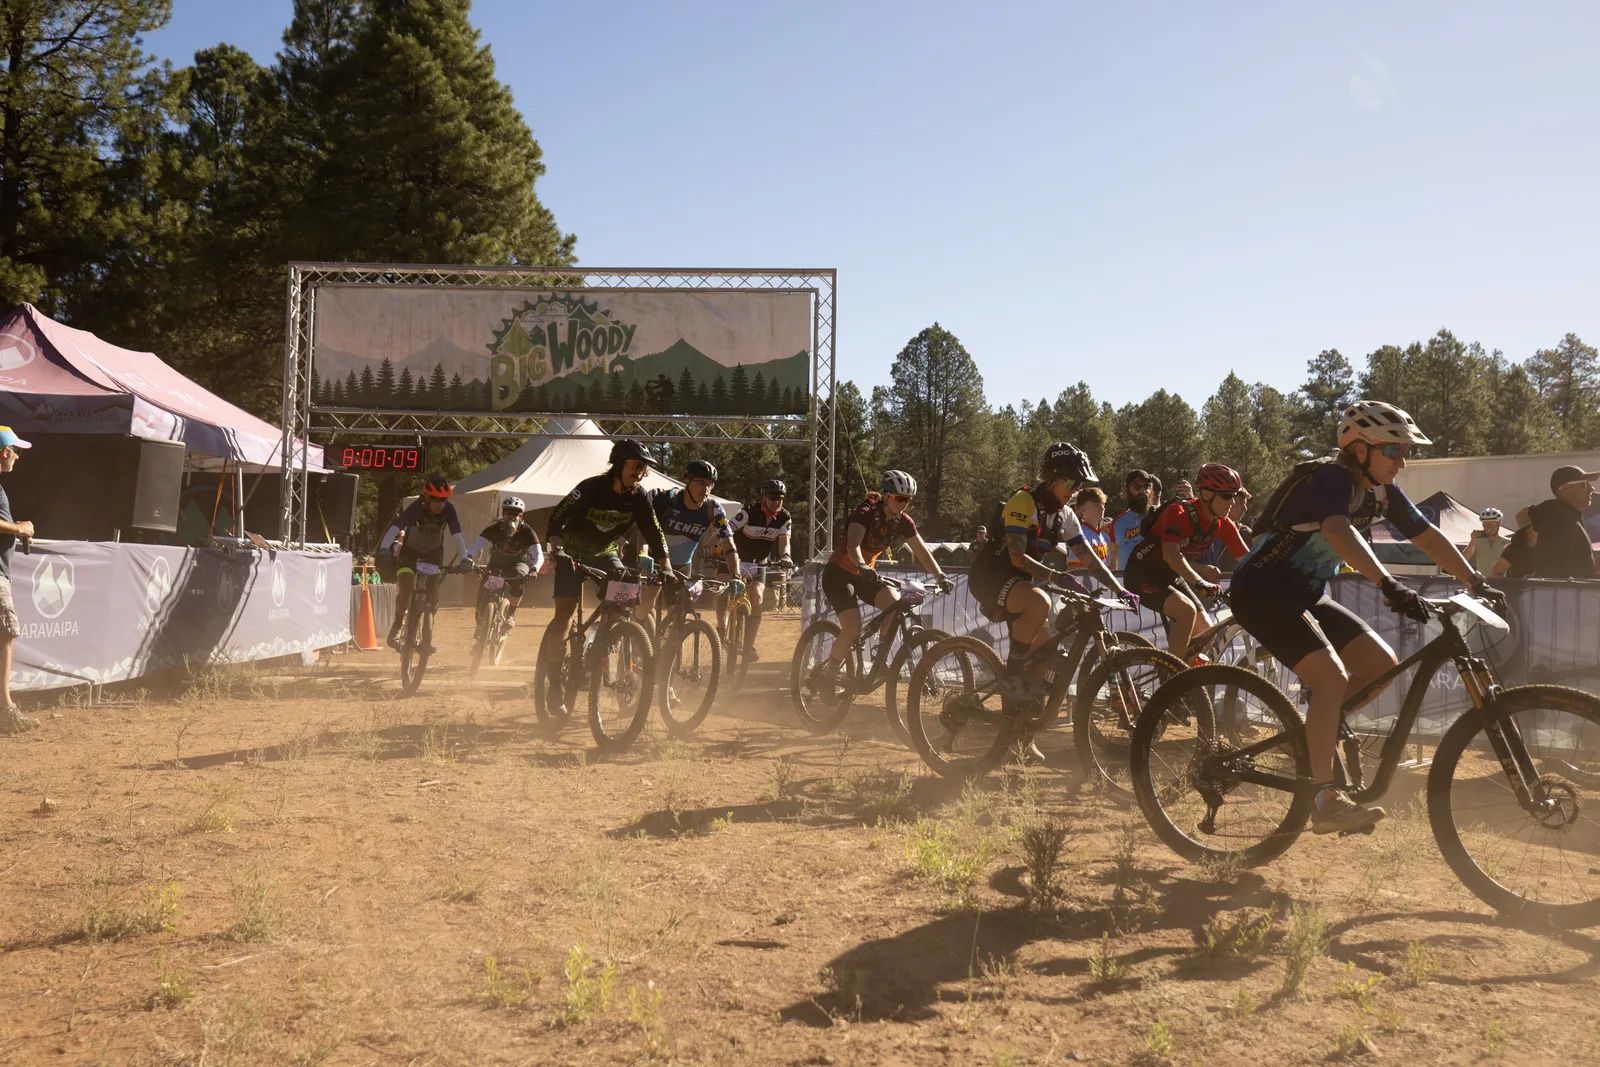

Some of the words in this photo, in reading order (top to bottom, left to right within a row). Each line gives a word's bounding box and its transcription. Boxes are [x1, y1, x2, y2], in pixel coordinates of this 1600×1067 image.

[490, 346, 547, 411] BIG
[547, 318, 638, 376] WOODY
[50, 410, 120, 421] ARAVAIPA
[1010, 511, 1028, 520] CST
[613, 592, 629, 600] 210
[20, 621, 79, 639] ARAVAIPA
